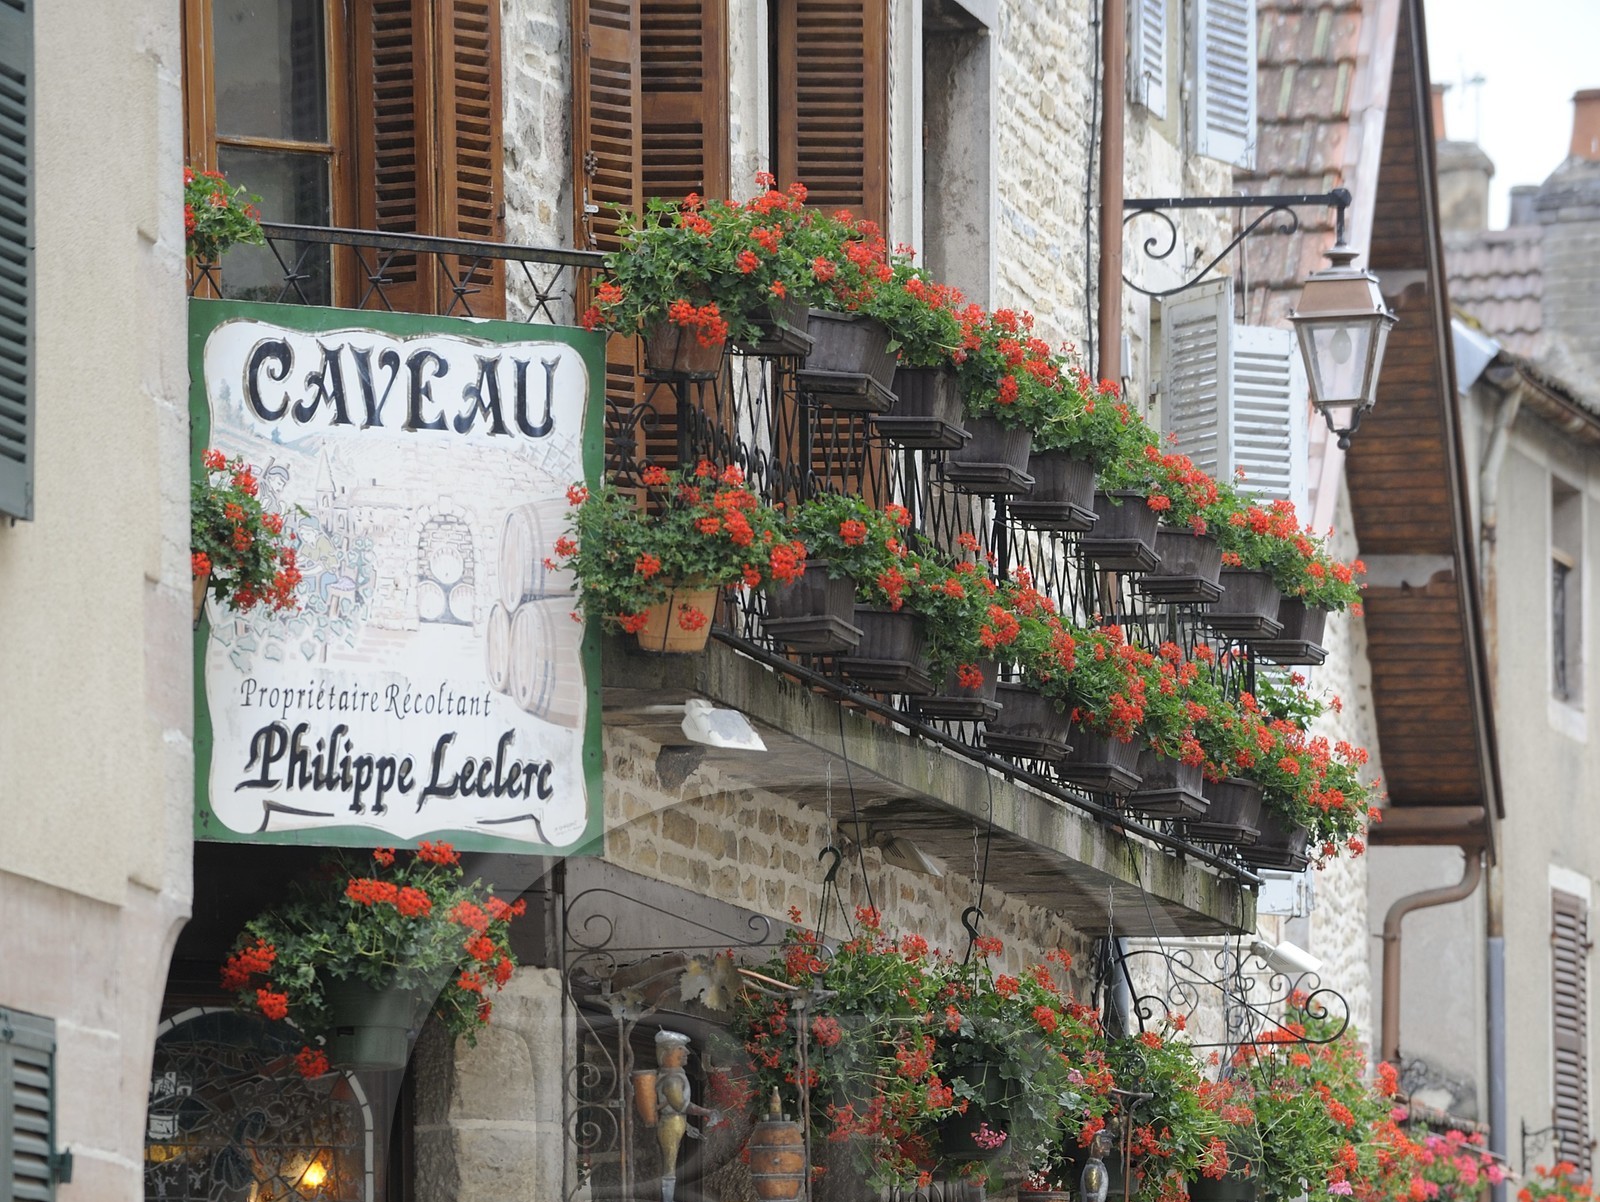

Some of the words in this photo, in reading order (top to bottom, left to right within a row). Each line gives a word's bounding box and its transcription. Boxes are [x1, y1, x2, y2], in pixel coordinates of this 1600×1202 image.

[242, 336, 562, 438] CAVEAU
[240, 678, 380, 720] Propriétaire
[384, 684, 492, 720] Récoltant
[234, 720, 415, 816] Philippe
[415, 727, 554, 814] Leclerc
